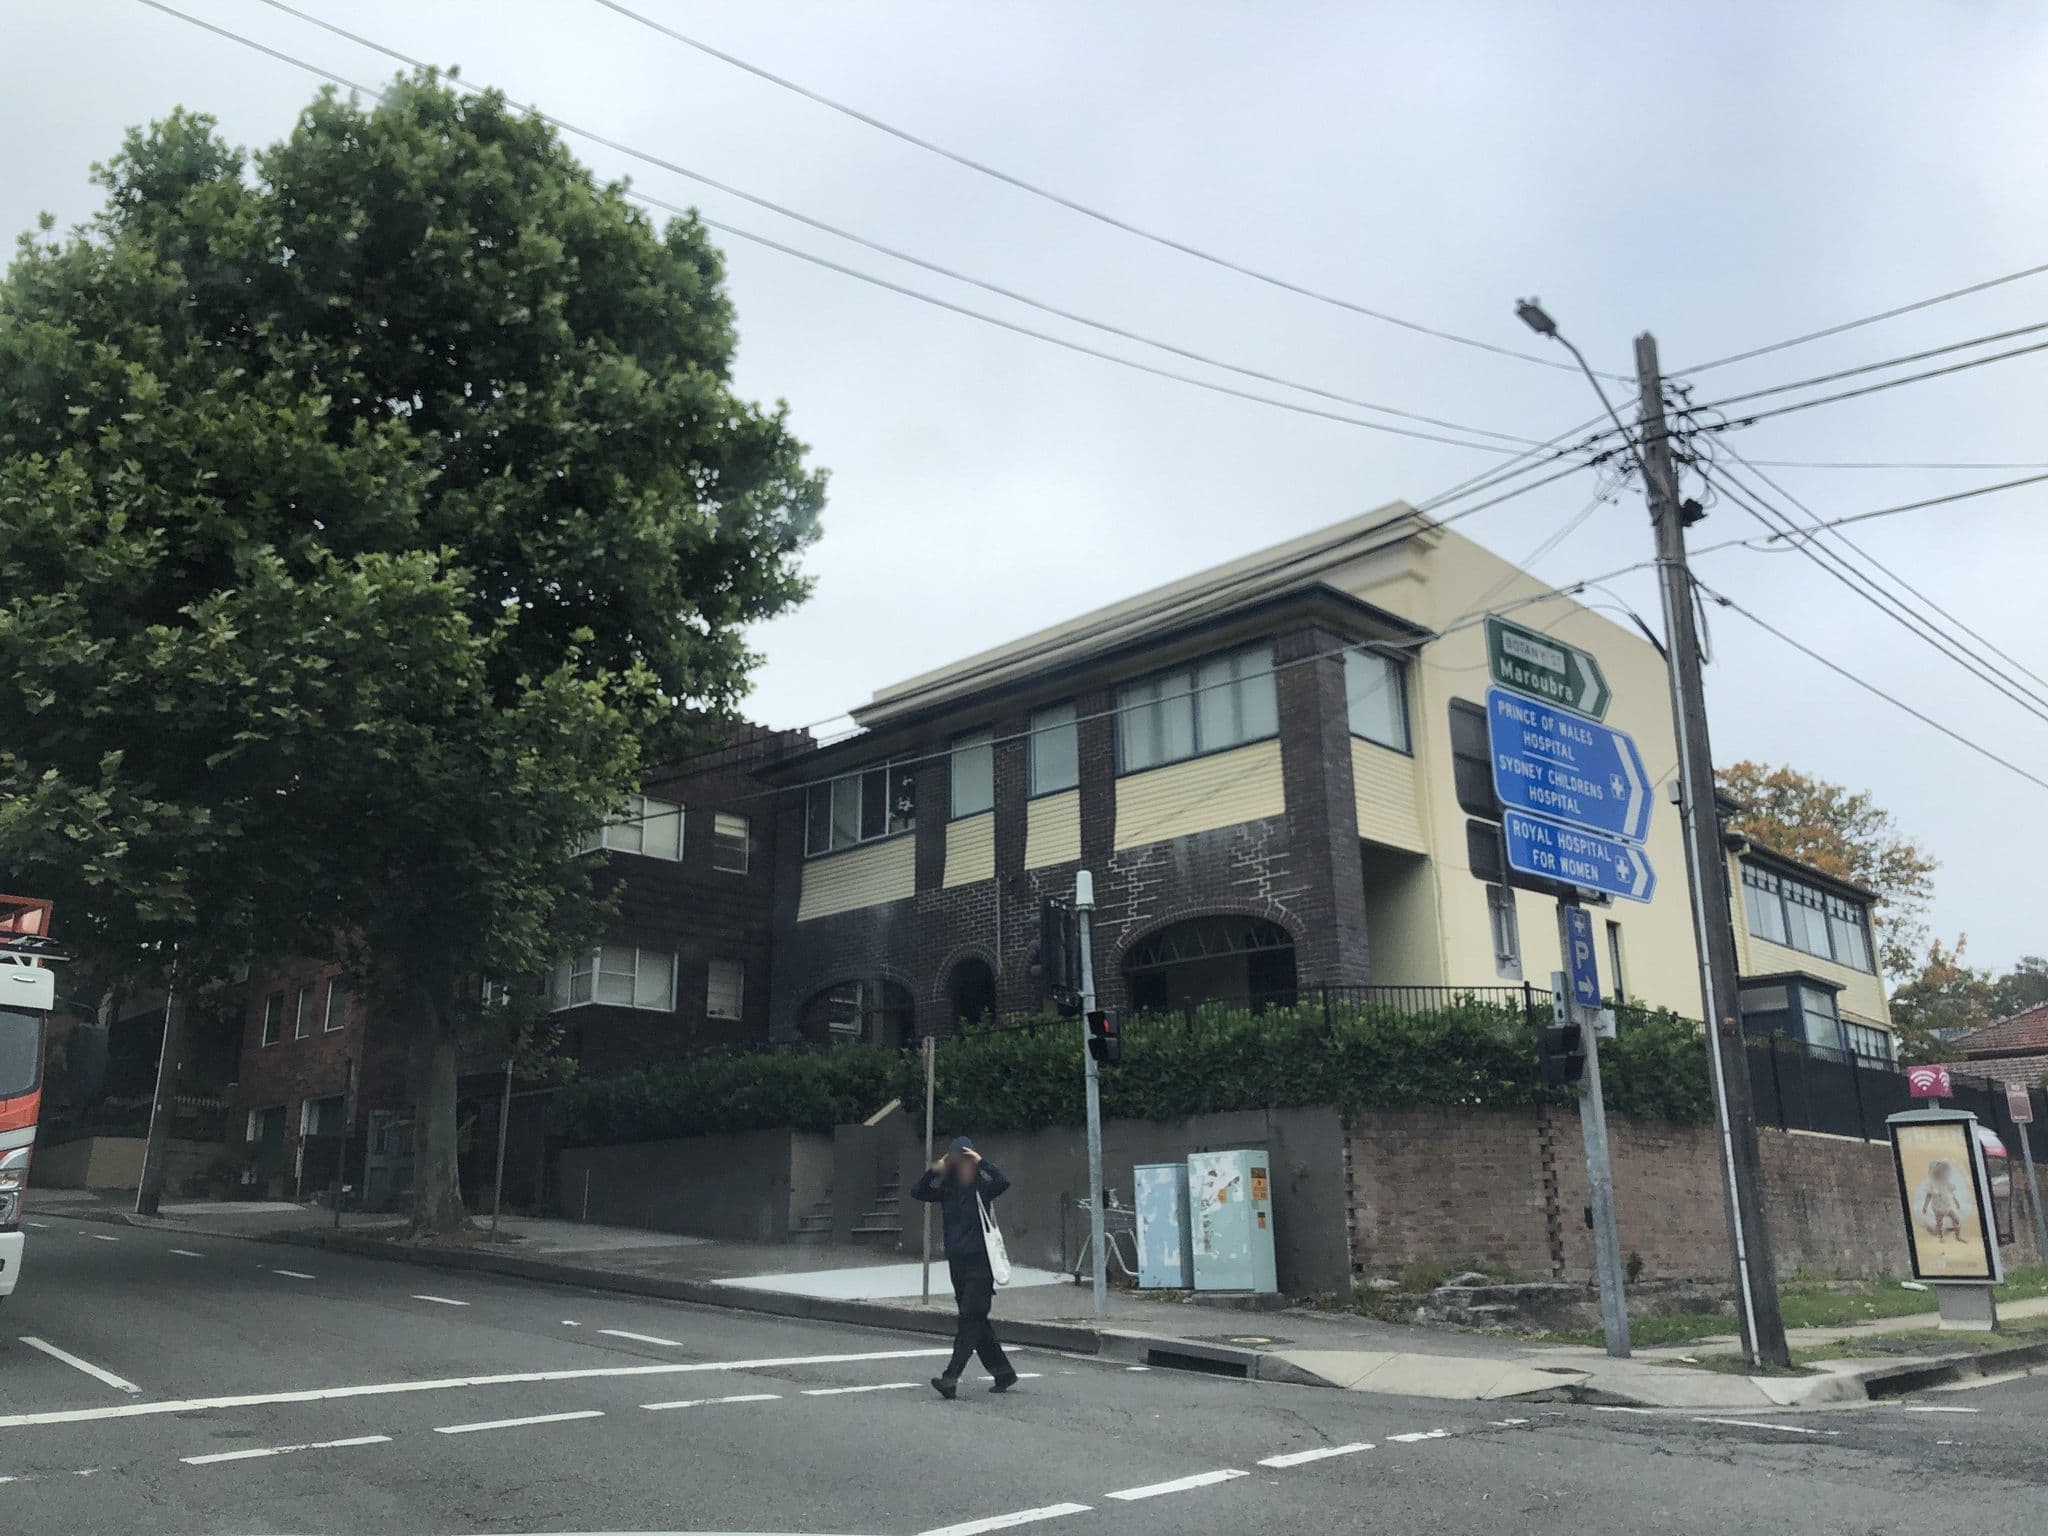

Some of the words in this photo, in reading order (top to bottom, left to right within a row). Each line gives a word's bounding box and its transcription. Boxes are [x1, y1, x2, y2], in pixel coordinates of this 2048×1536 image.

[1500, 658, 1573, 702] Maroubra
[1498, 700, 1537, 727] PRINCE
[1541, 715, 1554, 732] OF
[1559, 722, 1593, 746] WALES
[1523, 730, 1576, 761] HOSPITAL
[1500, 754, 1542, 780] SYDNEY
[1548, 769, 1604, 800] CHILDRENS
[1529, 785, 1581, 814] HOSPITAL
[1513, 819, 1552, 846] ROYAL
[1557, 831, 1612, 862] HOSPITAL
[1533, 848, 1555, 870] FOR
[1560, 856, 1599, 881] WOMEN
[1575, 940, 1590, 969] P
